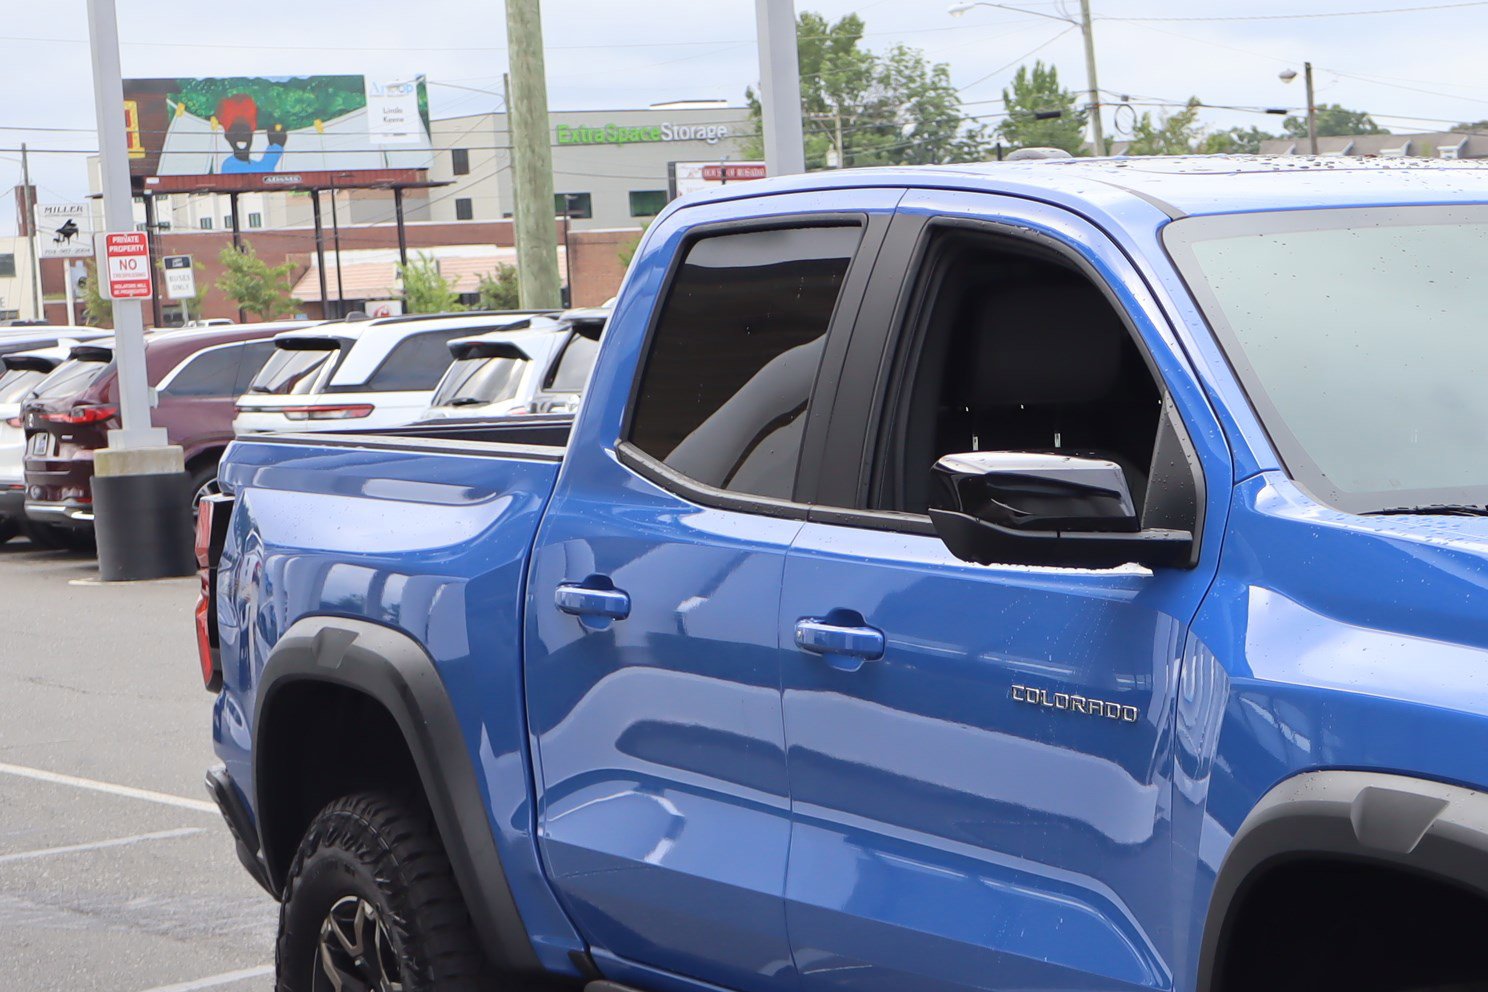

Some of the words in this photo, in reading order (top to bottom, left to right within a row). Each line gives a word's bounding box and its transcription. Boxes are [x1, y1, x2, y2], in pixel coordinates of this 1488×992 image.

[44, 205, 83, 214] MILLER
[112, 235, 140, 244] PRIVATE
[109, 244, 145, 253] PROPERTY
[119, 258, 138, 271] NO
[1011, 684, 1138, 723] COLORADO
